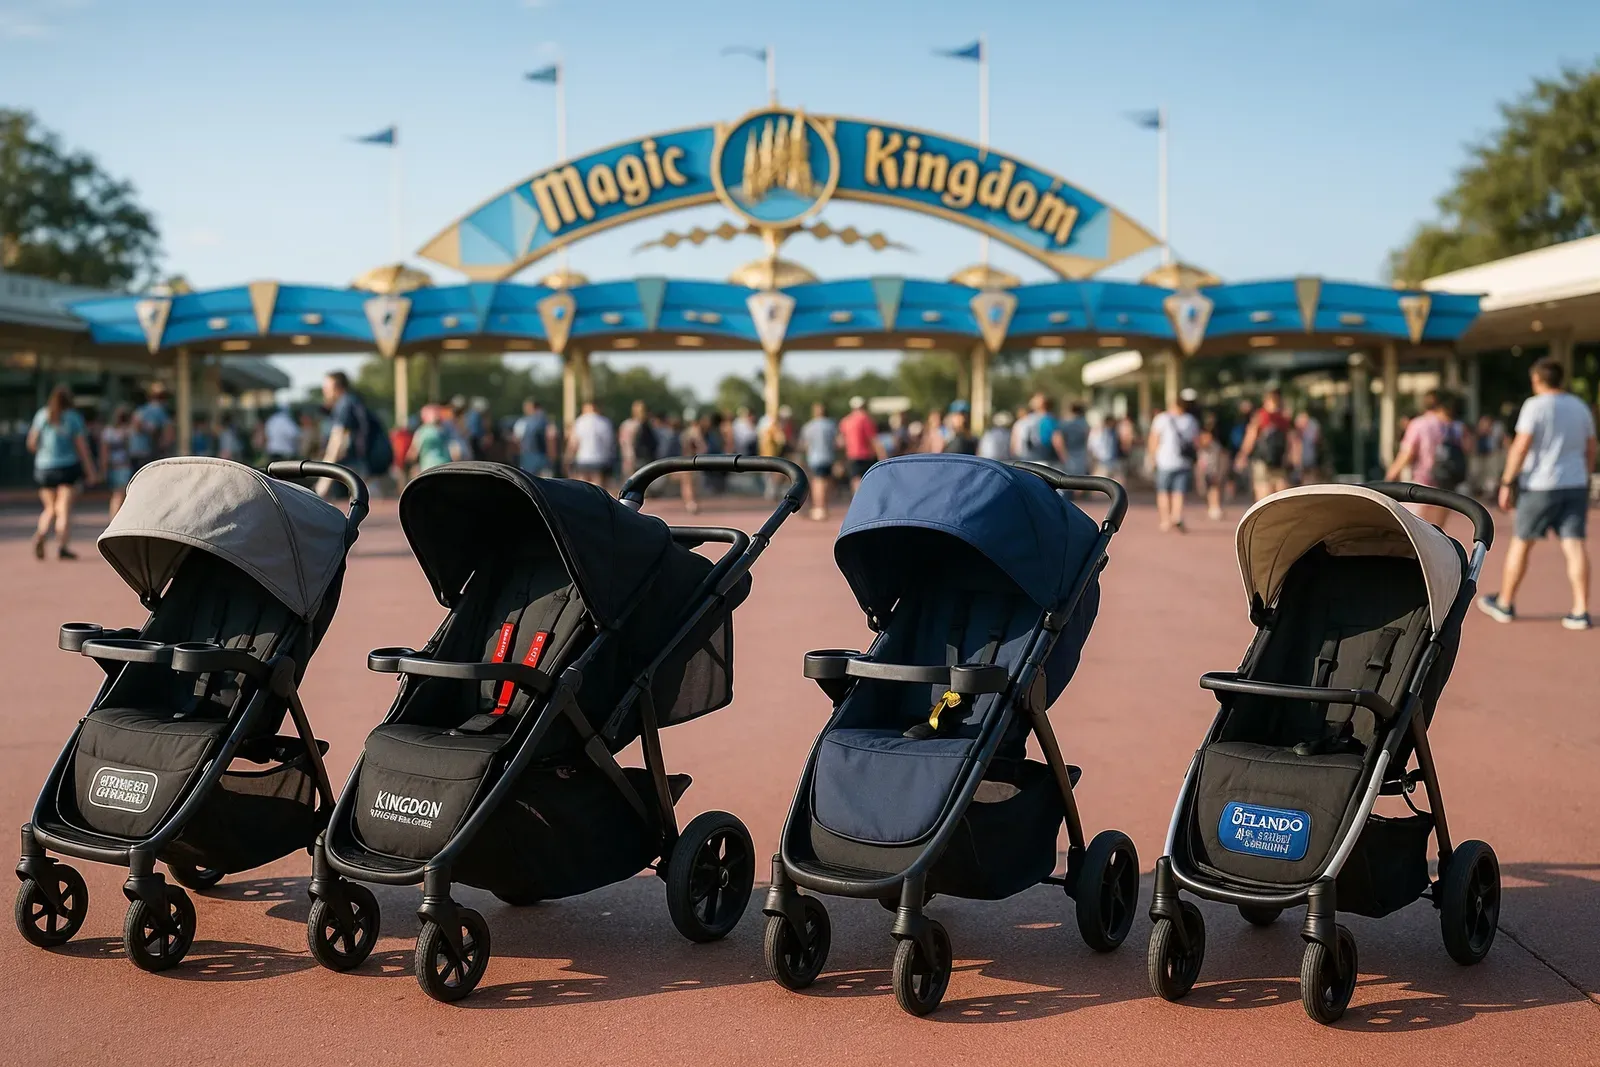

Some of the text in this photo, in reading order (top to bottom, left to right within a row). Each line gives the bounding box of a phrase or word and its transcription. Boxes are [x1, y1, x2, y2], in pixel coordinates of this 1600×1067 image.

[530, 127, 1079, 245] Magic Kingdom
[374, 790, 443, 818] KINGDON
